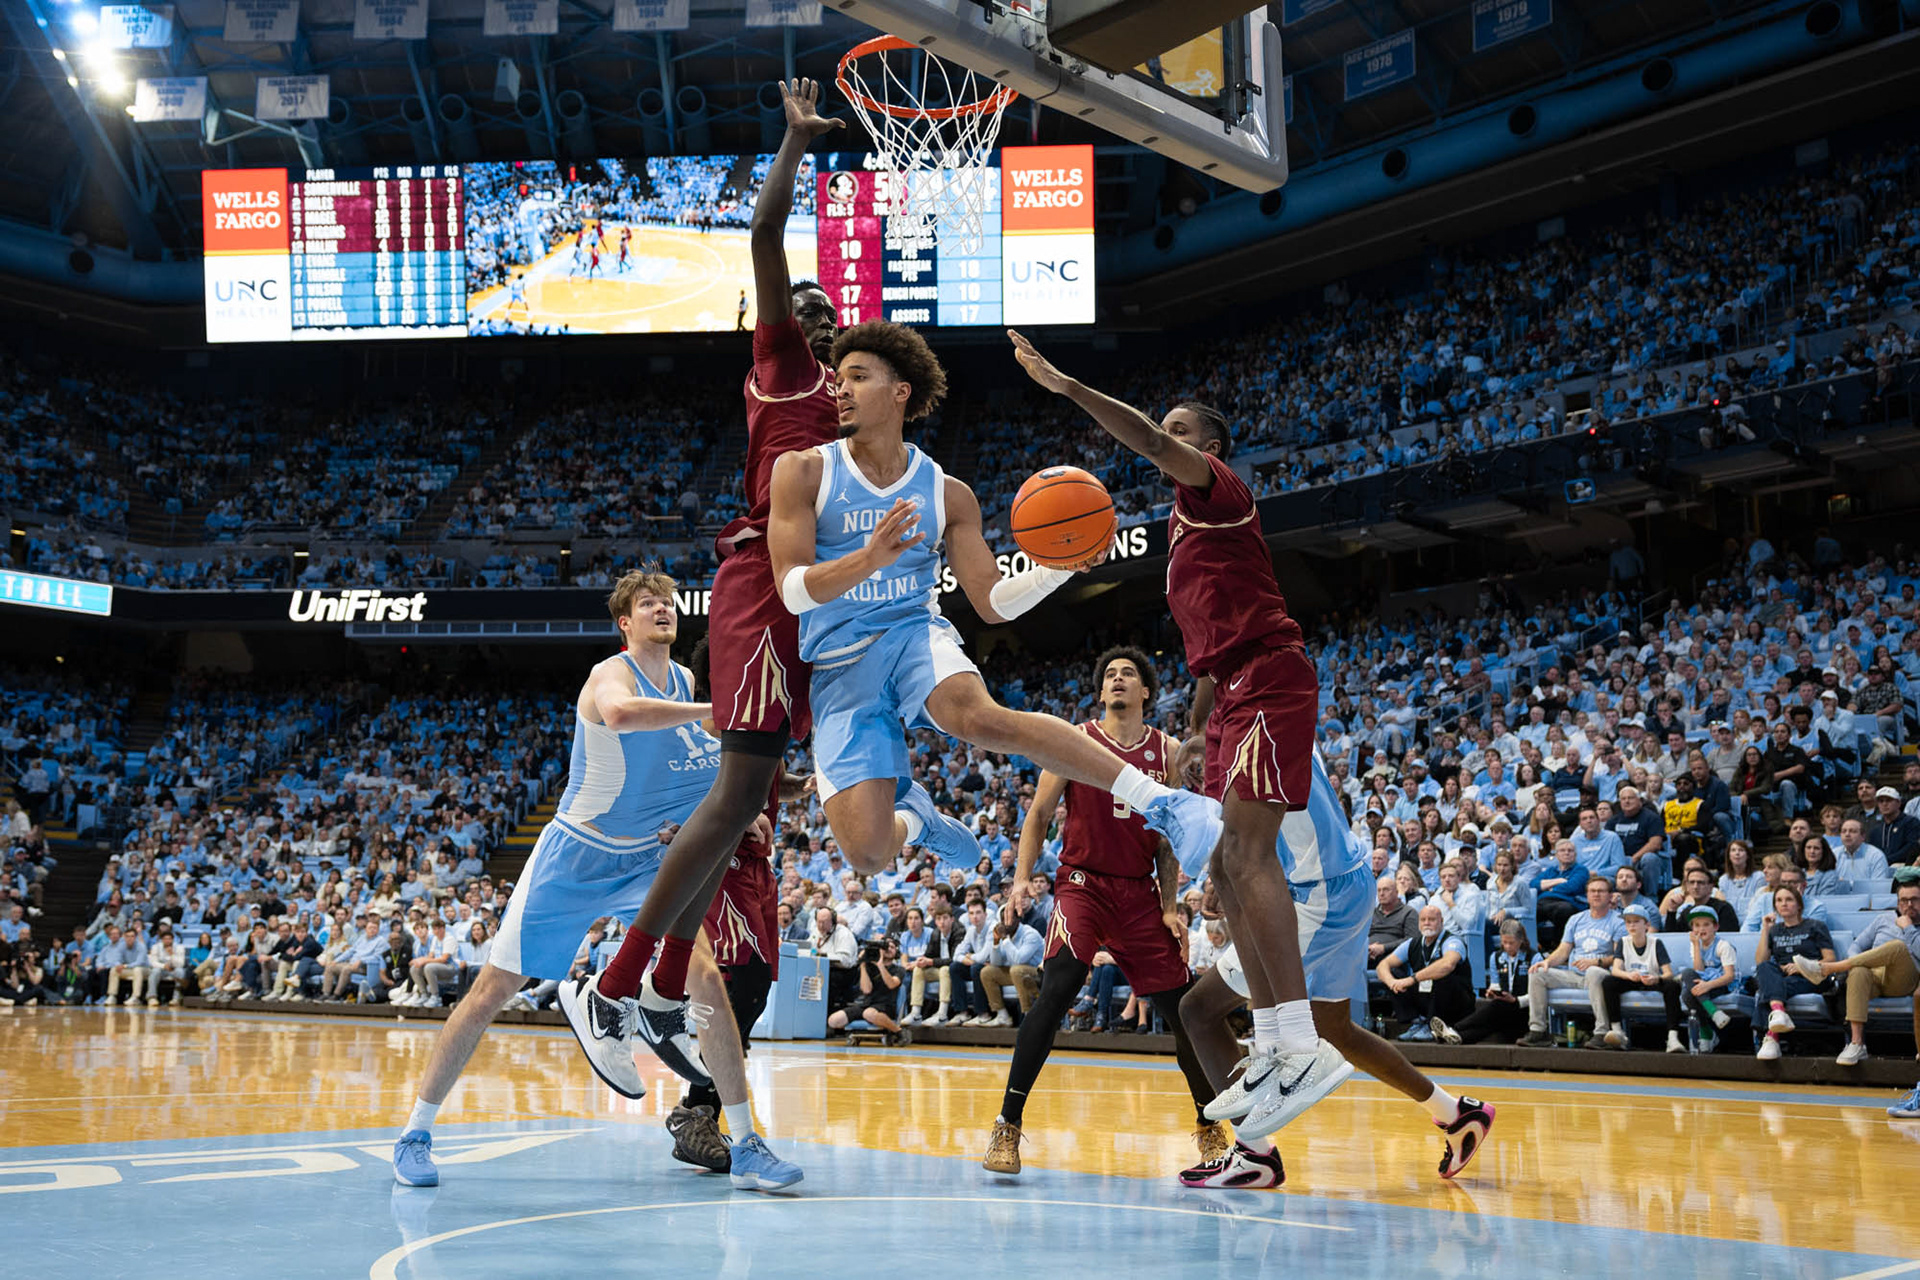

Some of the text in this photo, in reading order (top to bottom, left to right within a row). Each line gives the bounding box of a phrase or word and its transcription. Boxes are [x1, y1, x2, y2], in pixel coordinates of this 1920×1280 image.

[1498, 1, 1527, 23] 1979
[1367, 52, 1393, 73] 1978
[281, 95, 305, 106] 2017
[1011, 168, 1083, 187] WELLS
[294, 184, 298, 196] 1
[400, 180, 409, 194] 2
[425, 179, 431, 193] 1
[447, 178, 456, 193] 3
[213, 191, 280, 209] WELLS
[378, 195, 387, 208] 0
[401, 195, 410, 208] 0
[426, 194, 431, 207] 1
[449, 193, 455, 207] 1
[1013, 190, 1083, 208] FARGO
[215, 212, 281, 230] FARGO
[401, 209, 410, 222] 2
[426, 208, 431, 222] 1
[447, 207, 456, 222] 2
[293, 226, 301, 239] 7
[376, 224, 390, 238] 10
[425, 223, 434, 236] 0
[448, 222, 457, 236] 0
[845, 218, 854, 237] 1
[379, 238, 387, 252] 4
[404, 238, 409, 252] 1
[425, 237, 434, 251] 0
[450, 237, 455, 250] 1
[839, 240, 861, 259] 10
[404, 252, 409, 266] 1
[426, 252, 434, 265] 0
[450, 251, 456, 265] 1
[294, 270, 302, 282] 7
[377, 267, 390, 280] 14
[451, 266, 456, 279] 1
[844, 263, 857, 281] 4
[1012, 260, 1079, 283] UNC
[215, 279, 278, 301] UNC
[451, 280, 456, 293] 1
[841, 285, 861, 304] 17
[909, 287, 937, 299] POINTS
[295, 299, 303, 310] 11
[426, 295, 435, 309] 2
[451, 294, 457, 308] 1
[216, 307, 278, 318] HEALTH
[402, 310, 415, 324] 10
[427, 309, 435, 323] 3
[450, 309, 459, 323] 3
[841, 305, 979, 326] 11 ASSISTS 17
[840, 575, 919, 602] ROLINA
[288, 589, 428, 622] UniFirst
